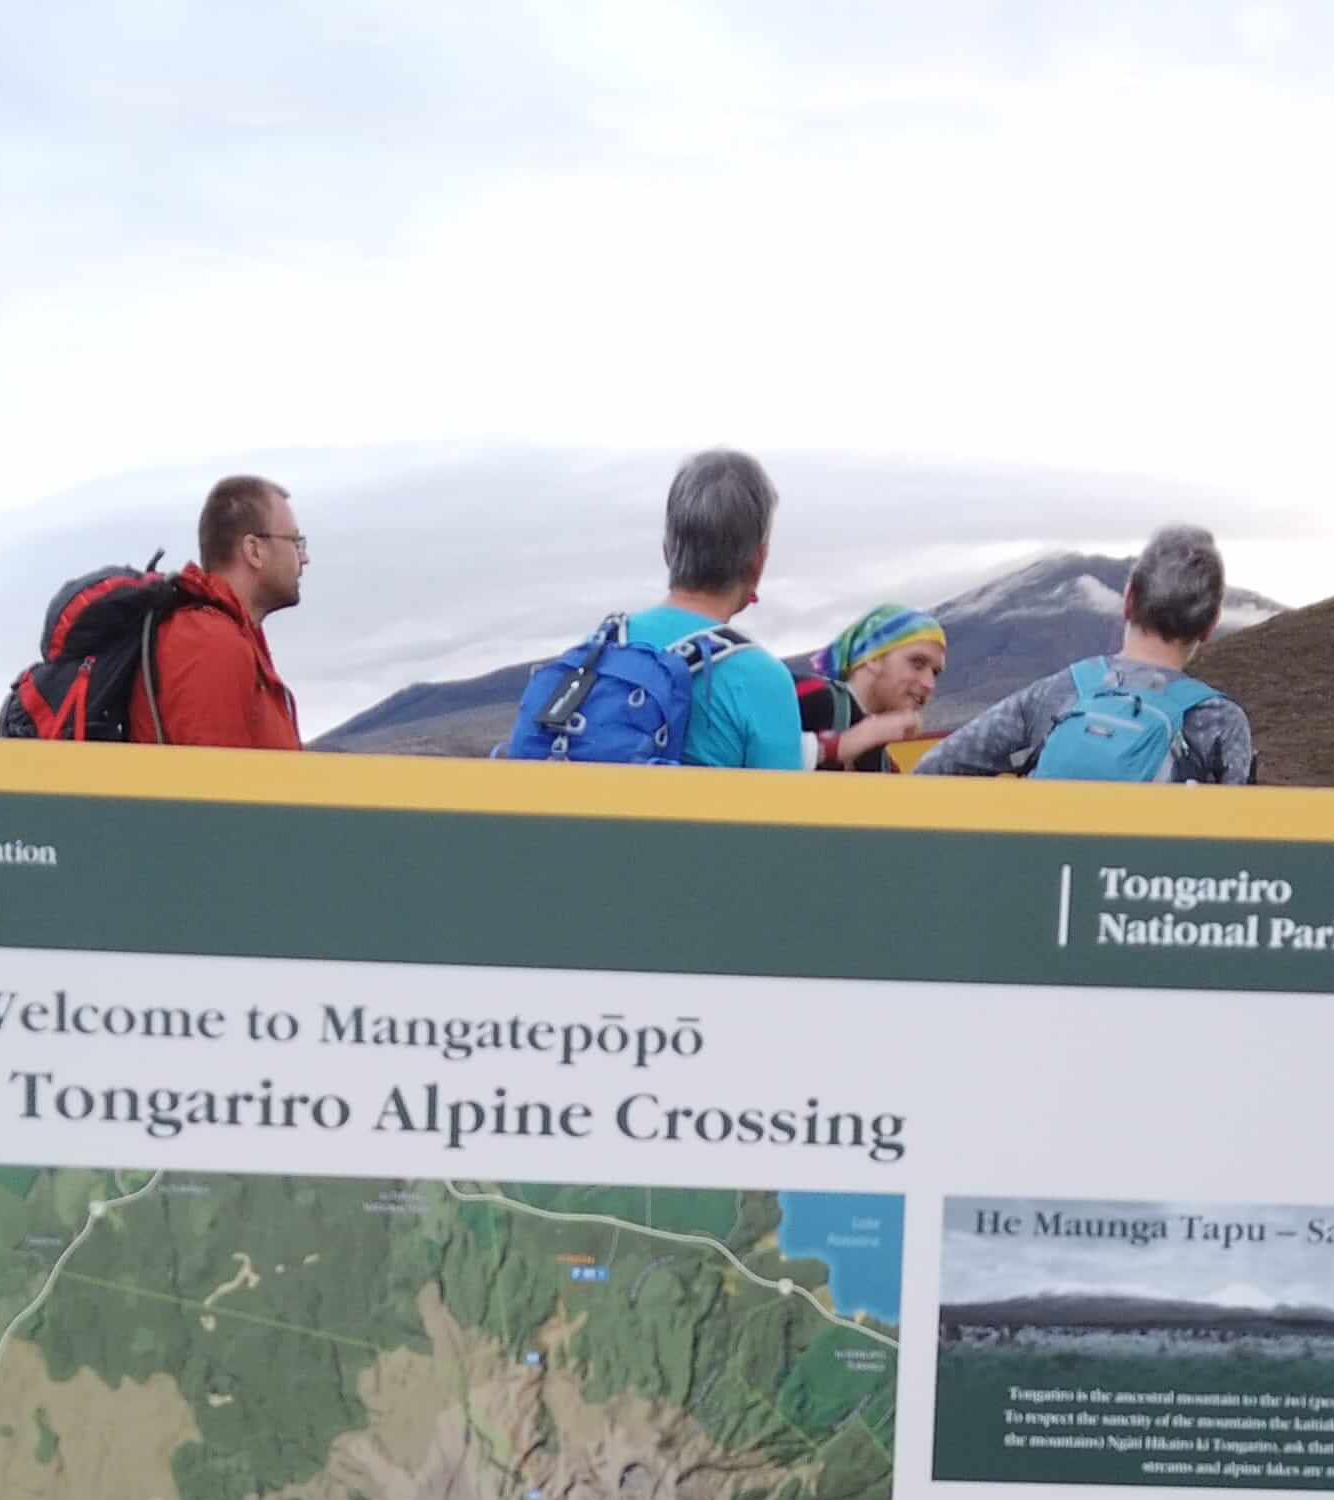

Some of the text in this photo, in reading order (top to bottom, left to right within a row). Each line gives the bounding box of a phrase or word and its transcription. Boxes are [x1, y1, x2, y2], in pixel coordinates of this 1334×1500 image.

[1099, 869, 1291, 906] Tongariro
[1097, 914, 1258, 946] National
[246, 998, 300, 1042] to
[321, 1004, 704, 1067] Mangatepōpō
[11, 1073, 350, 1135] Tongariro
[377, 1085, 590, 1147] Alpine
[615, 1096, 904, 1159] Crossing
[974, 1210, 1022, 1235] He
[1033, 1211, 1167, 1244] Maunga
[1180, 1216, 1267, 1247] Tapu
